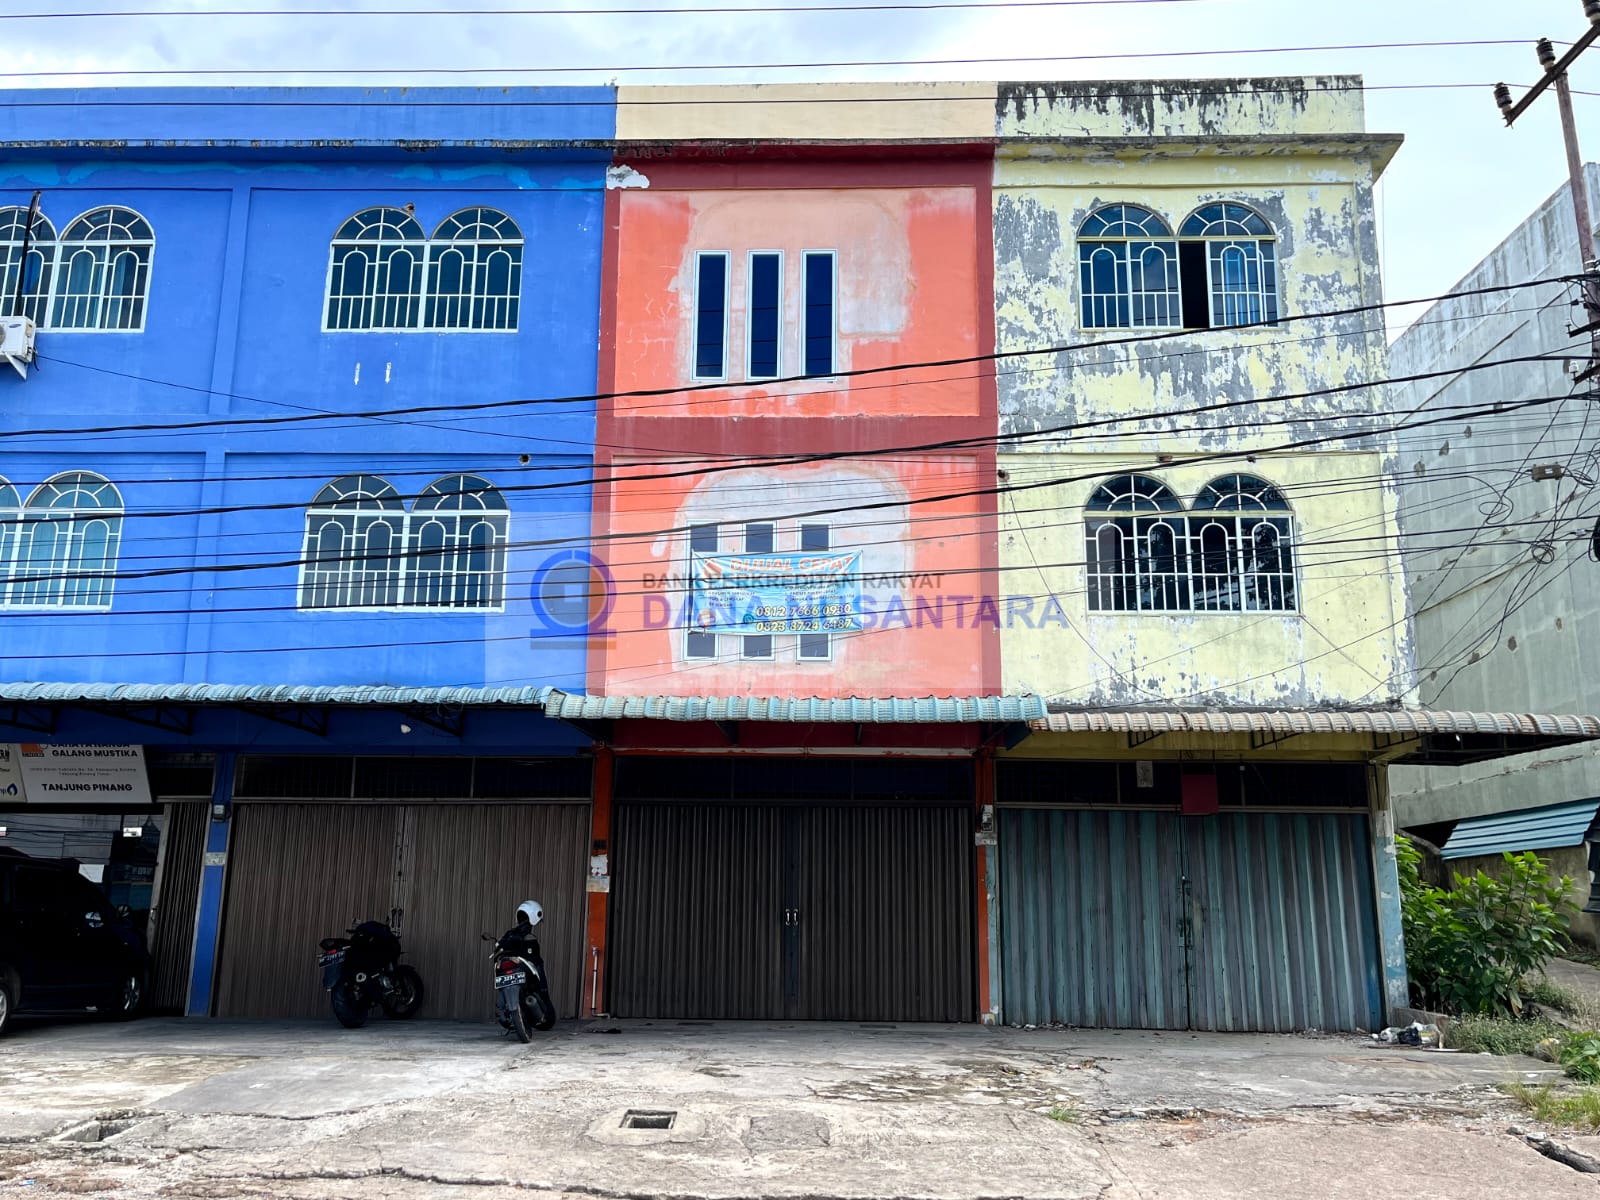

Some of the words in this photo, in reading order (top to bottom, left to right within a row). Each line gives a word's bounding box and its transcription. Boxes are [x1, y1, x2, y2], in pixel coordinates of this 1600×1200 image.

[730, 558, 793, 572] DIJUAL
[799, 556, 854, 572] CEPAT
[756, 606, 786, 617] 0812
[756, 620, 786, 632] 0823
[52, 749, 92, 757] GALANG
[94, 749, 138, 757] MUSTIKA
[41, 783, 91, 791] TANJUNG
[93, 783, 133, 791] PINANG
